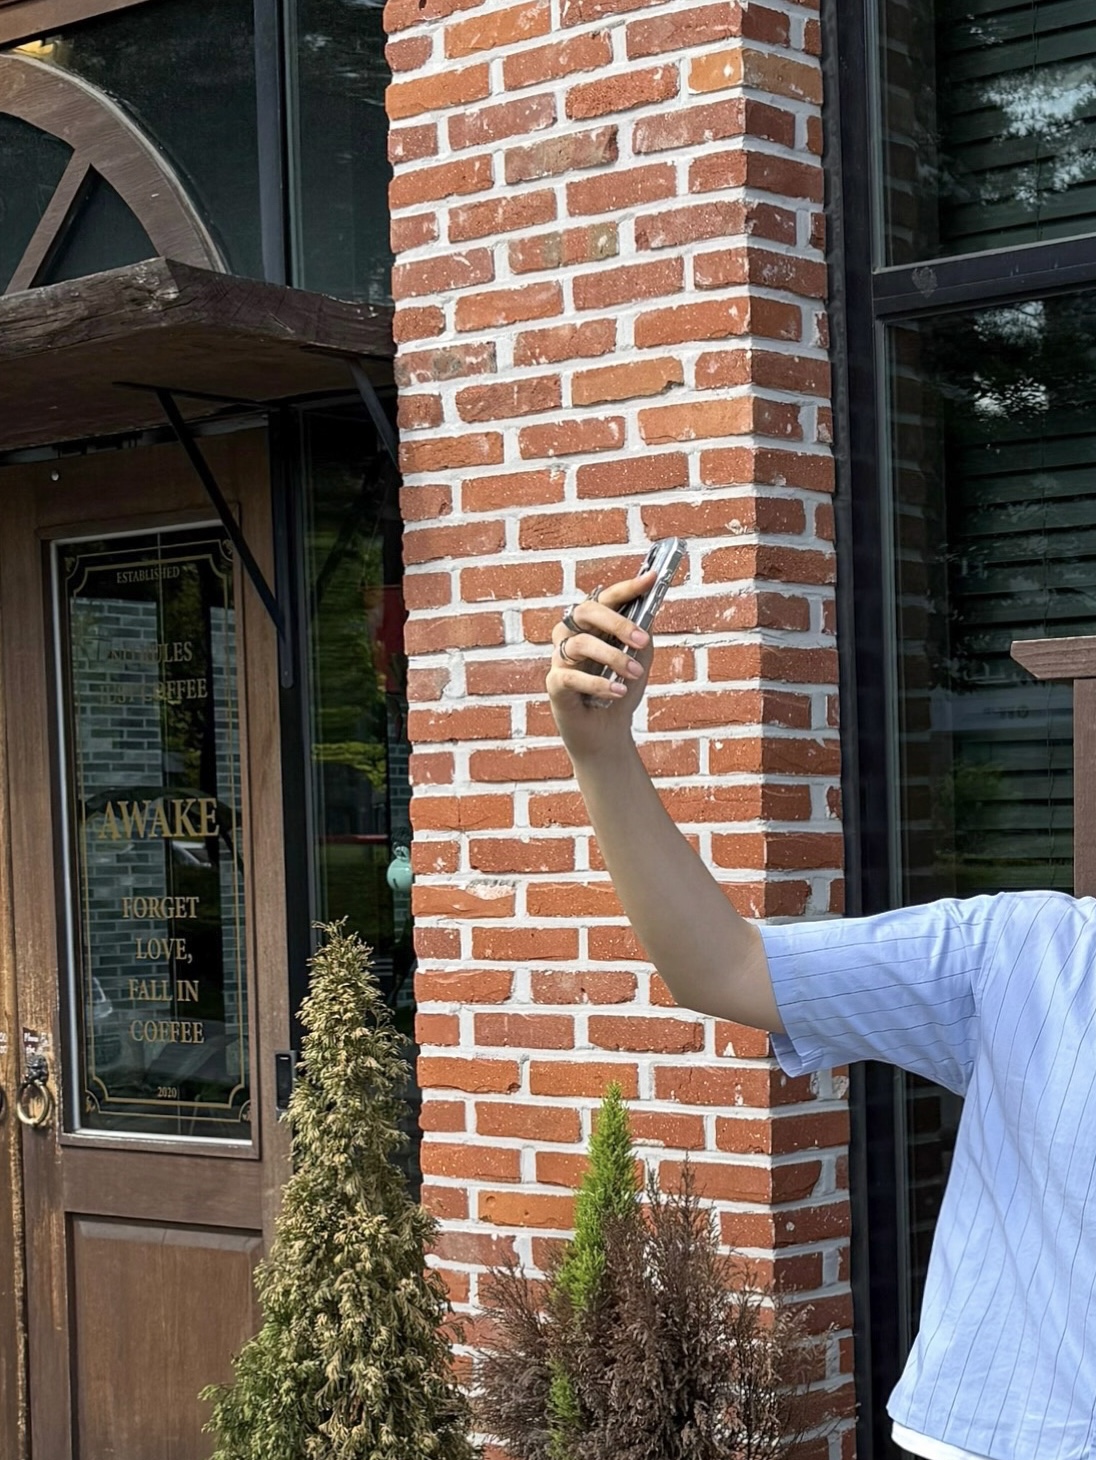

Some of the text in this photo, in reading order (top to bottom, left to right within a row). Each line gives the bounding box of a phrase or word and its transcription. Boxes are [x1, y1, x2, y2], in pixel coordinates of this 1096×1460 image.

[116, 566, 180, 584] ESTABLISHED
[99, 797, 220, 839] AWAKE
[122, 897, 199, 918] FORGET
[136, 938, 193, 964] LOVE,
[129, 979, 199, 1002] FALL IN
[131, 1021, 204, 1044] COFFEE
[157, 1086, 177, 1099] 2020
